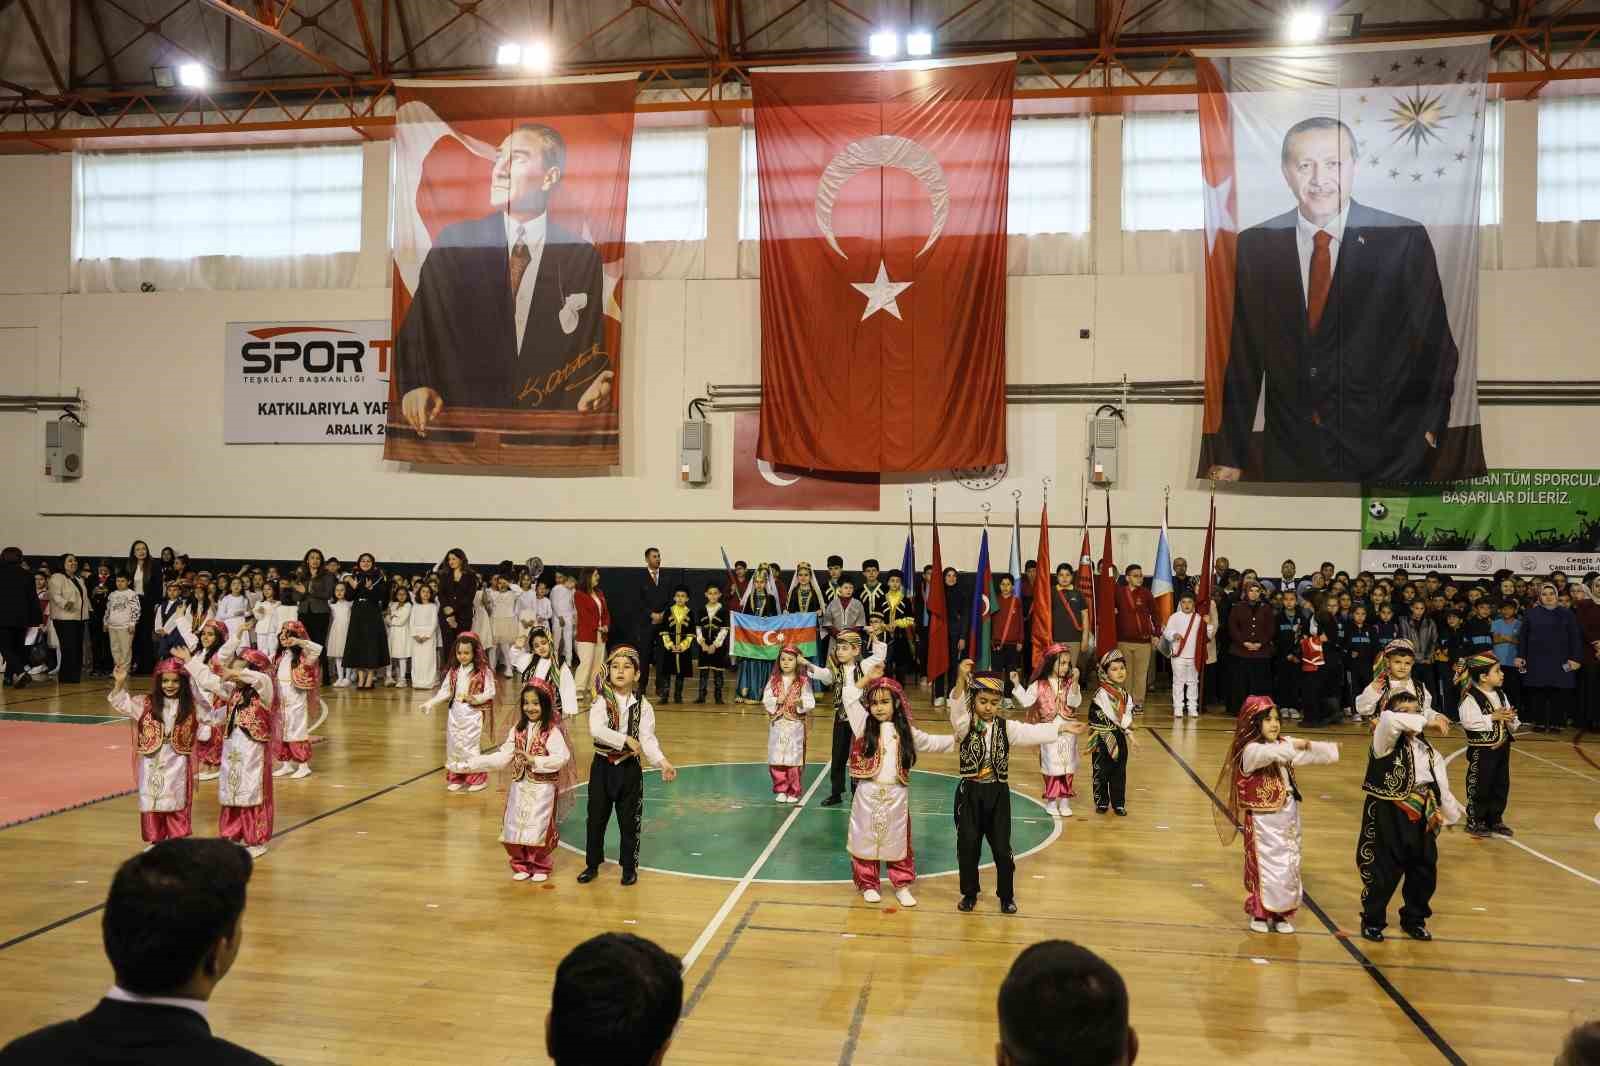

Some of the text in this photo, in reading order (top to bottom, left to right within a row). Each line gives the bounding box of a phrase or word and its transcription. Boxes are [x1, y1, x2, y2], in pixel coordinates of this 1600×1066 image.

[243, 374, 365, 384] TEŞKİLAT BAŞKANLIĞI
[258, 402, 359, 415] KATKILARIYLA
[325, 424, 373, 435] ARALIK
[1503, 471, 1531, 486] TÜM
[1442, 487, 1572, 505] BAŞARILAR DİLERİZ.
[1425, 553, 1448, 562] ÇELİK
